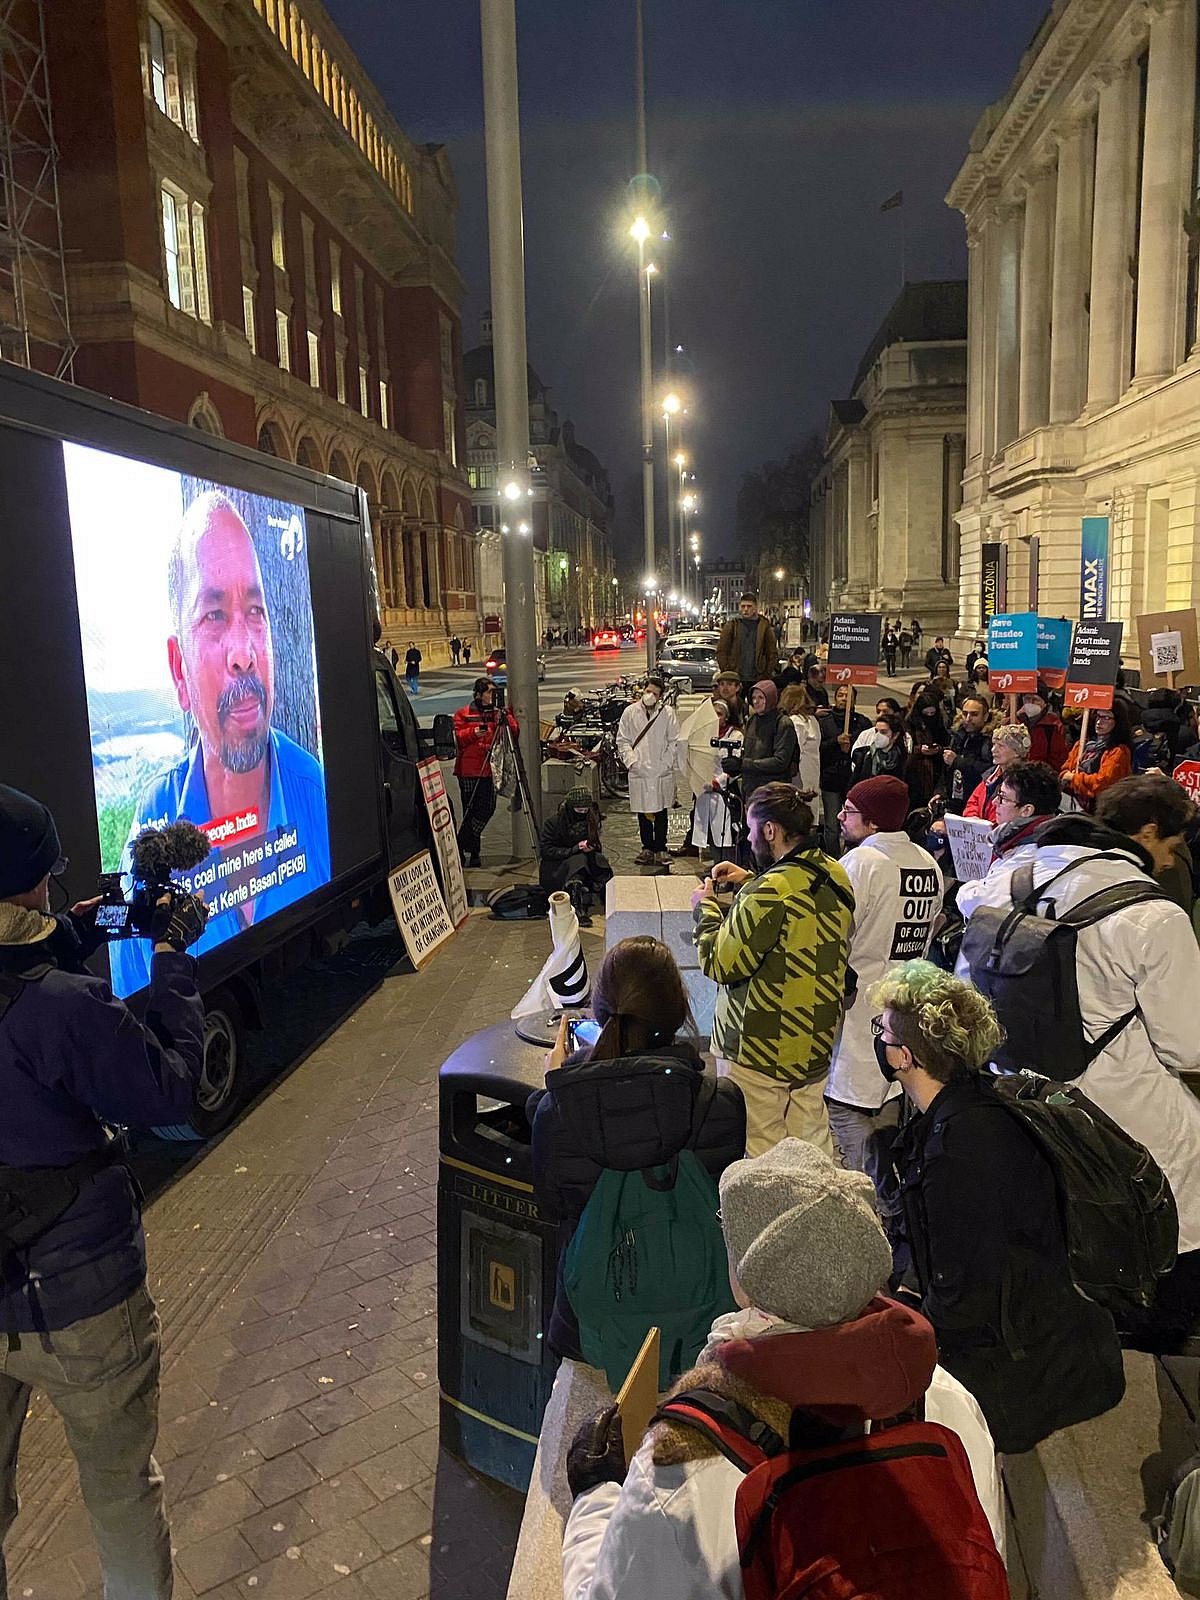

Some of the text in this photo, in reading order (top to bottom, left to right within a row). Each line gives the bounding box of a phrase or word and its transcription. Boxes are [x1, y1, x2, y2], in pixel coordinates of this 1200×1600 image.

[1084, 559, 1098, 618] IMAX
[991, 619, 1012, 627] Save
[832, 634, 870, 642] Indigenous
[991, 630, 1023, 638] Hasdeo
[991, 641, 1018, 649] Forest
[1074, 647, 1110, 656] Indigenous
[1073, 657, 1091, 665] lands
[236, 812, 256, 832] India
[194, 864, 216, 889] coal
[218, 857, 242, 878] mine
[242, 848, 263, 870] here
[264, 841, 272, 857] is
[274, 830, 297, 850] called
[409, 864, 422, 883] LOOK
[423, 859, 431, 873] AS
[208, 853, 306, 917] st Kente Basan [PEKB]
[401, 874, 434, 906] THOUGH THEY
[905, 874, 935, 893] COAL
[401, 888, 439, 924] CARE AND HAVE
[904, 900, 933, 920] OUT
[410, 903, 445, 938] NO INTENTION
[900, 927, 911, 938] OF
[415, 936, 424, 953] OF
[472, 1185, 538, 1218] LITTER
